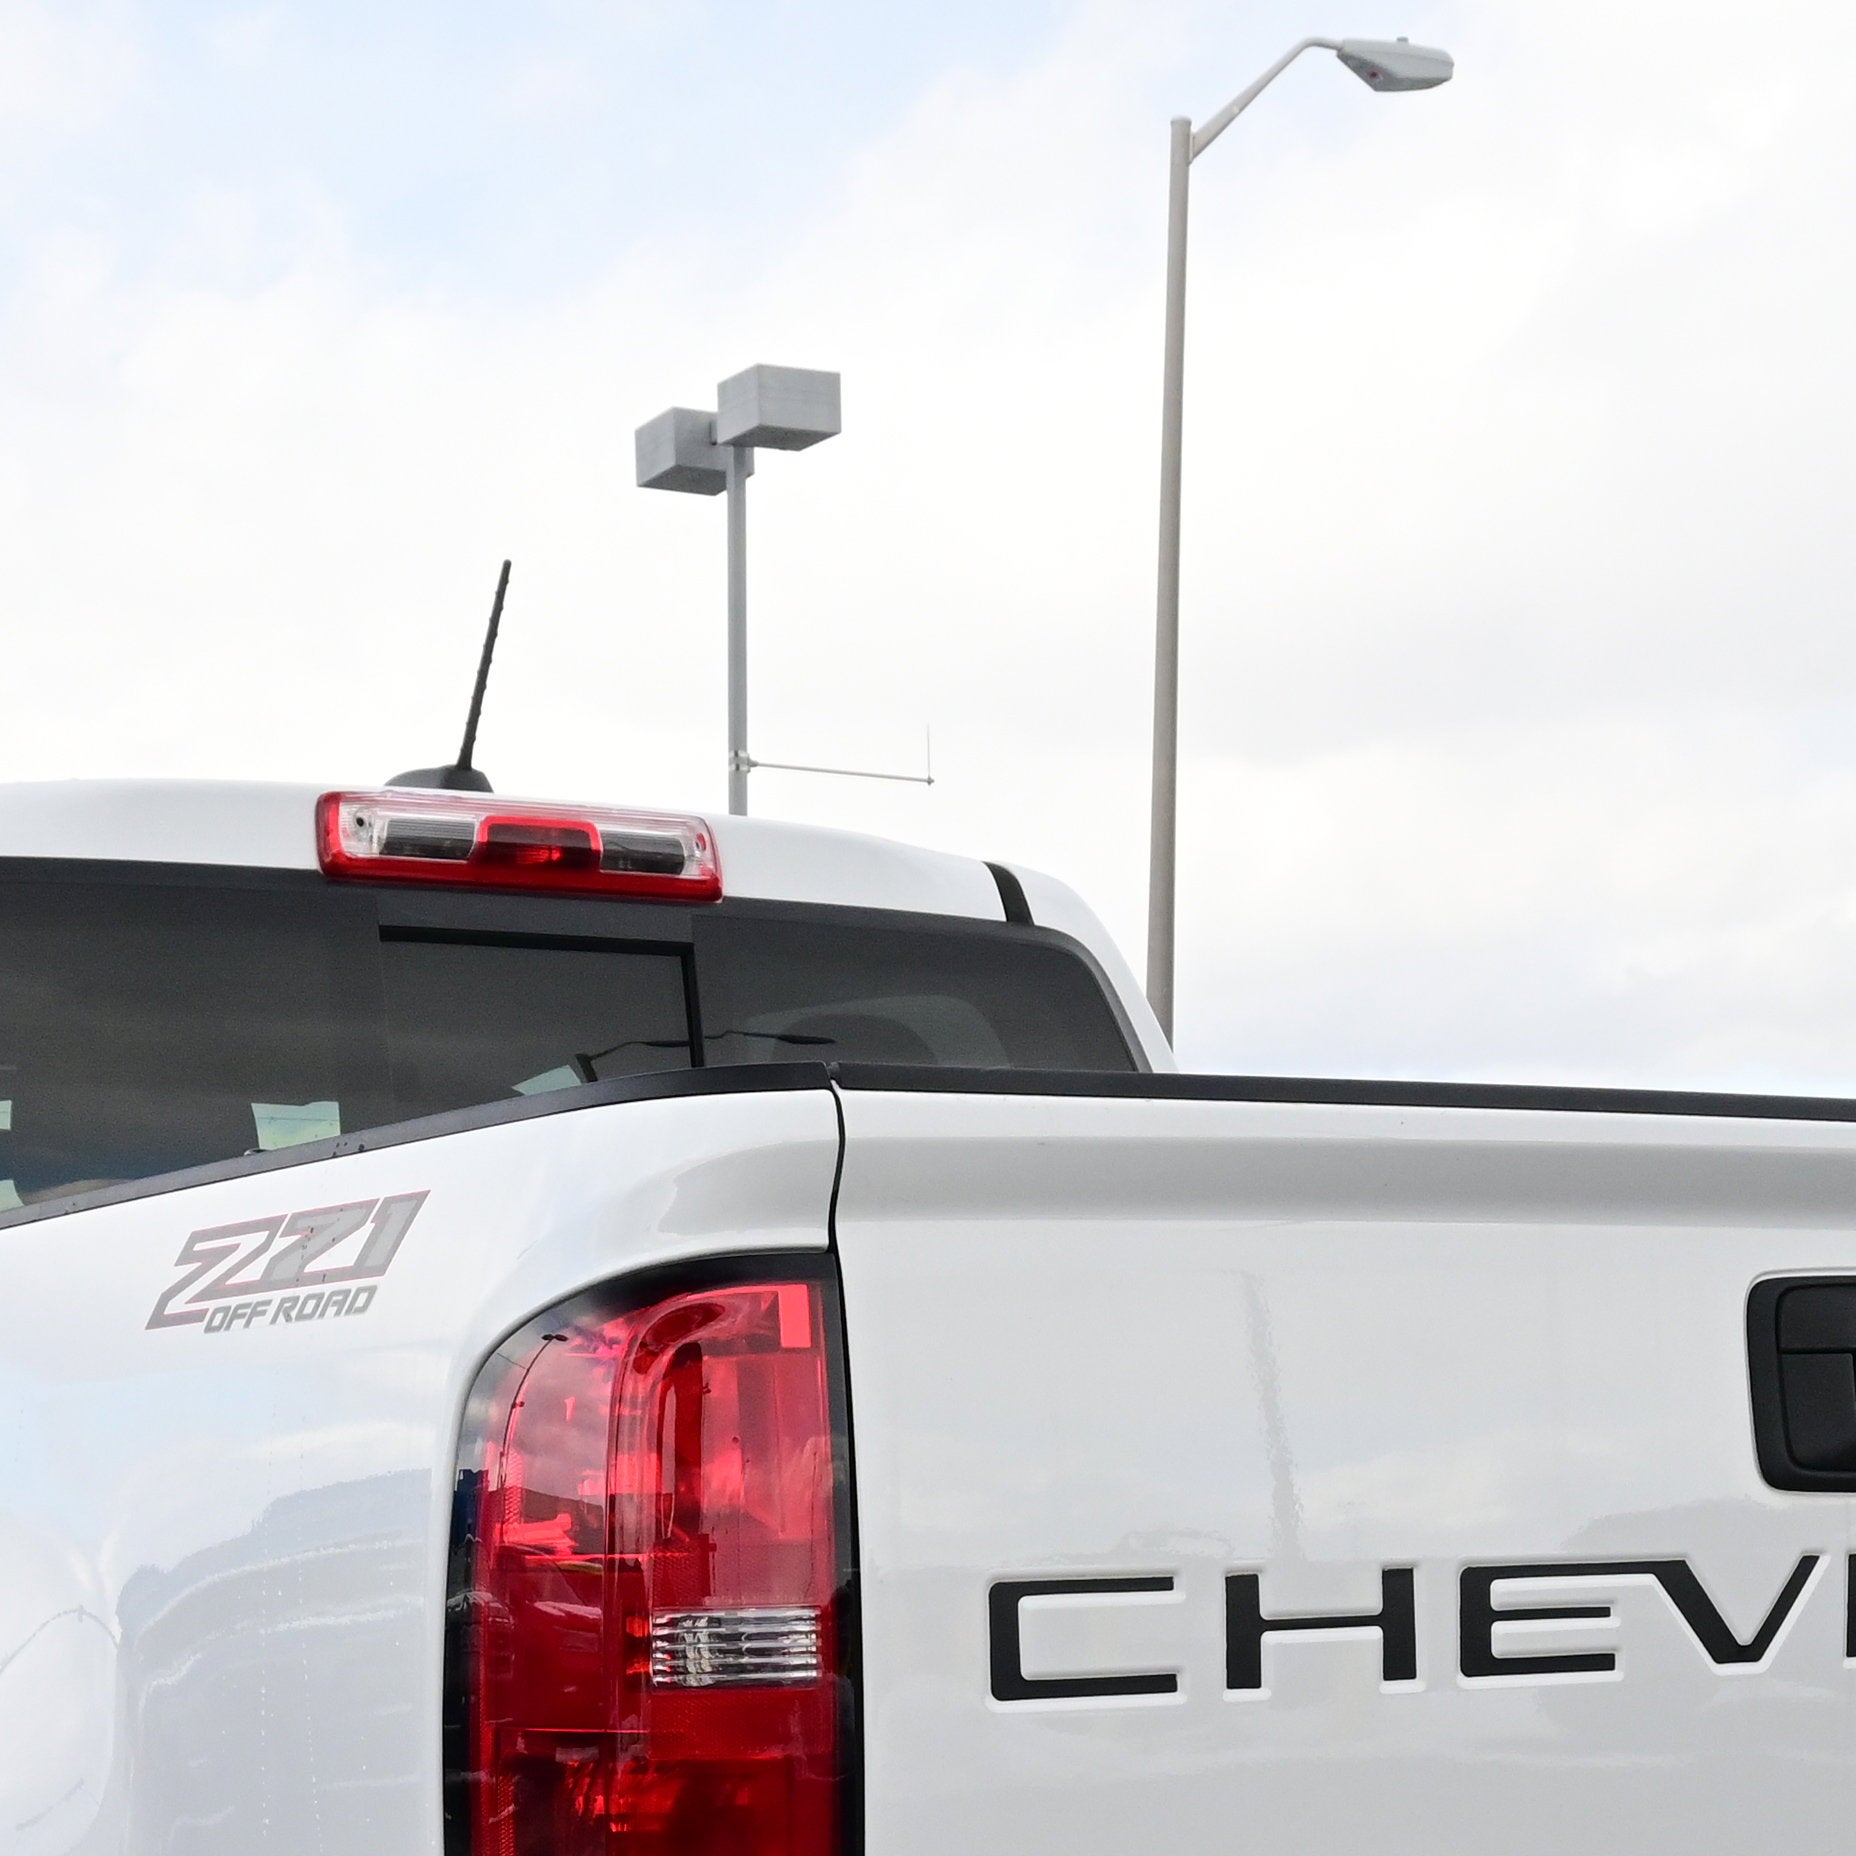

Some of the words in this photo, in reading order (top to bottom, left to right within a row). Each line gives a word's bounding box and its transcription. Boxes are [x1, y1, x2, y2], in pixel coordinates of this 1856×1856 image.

[145, 1189, 431, 1331] Z71
[204, 1299, 272, 1334] OFF
[270, 1285, 379, 1326] ROAD
